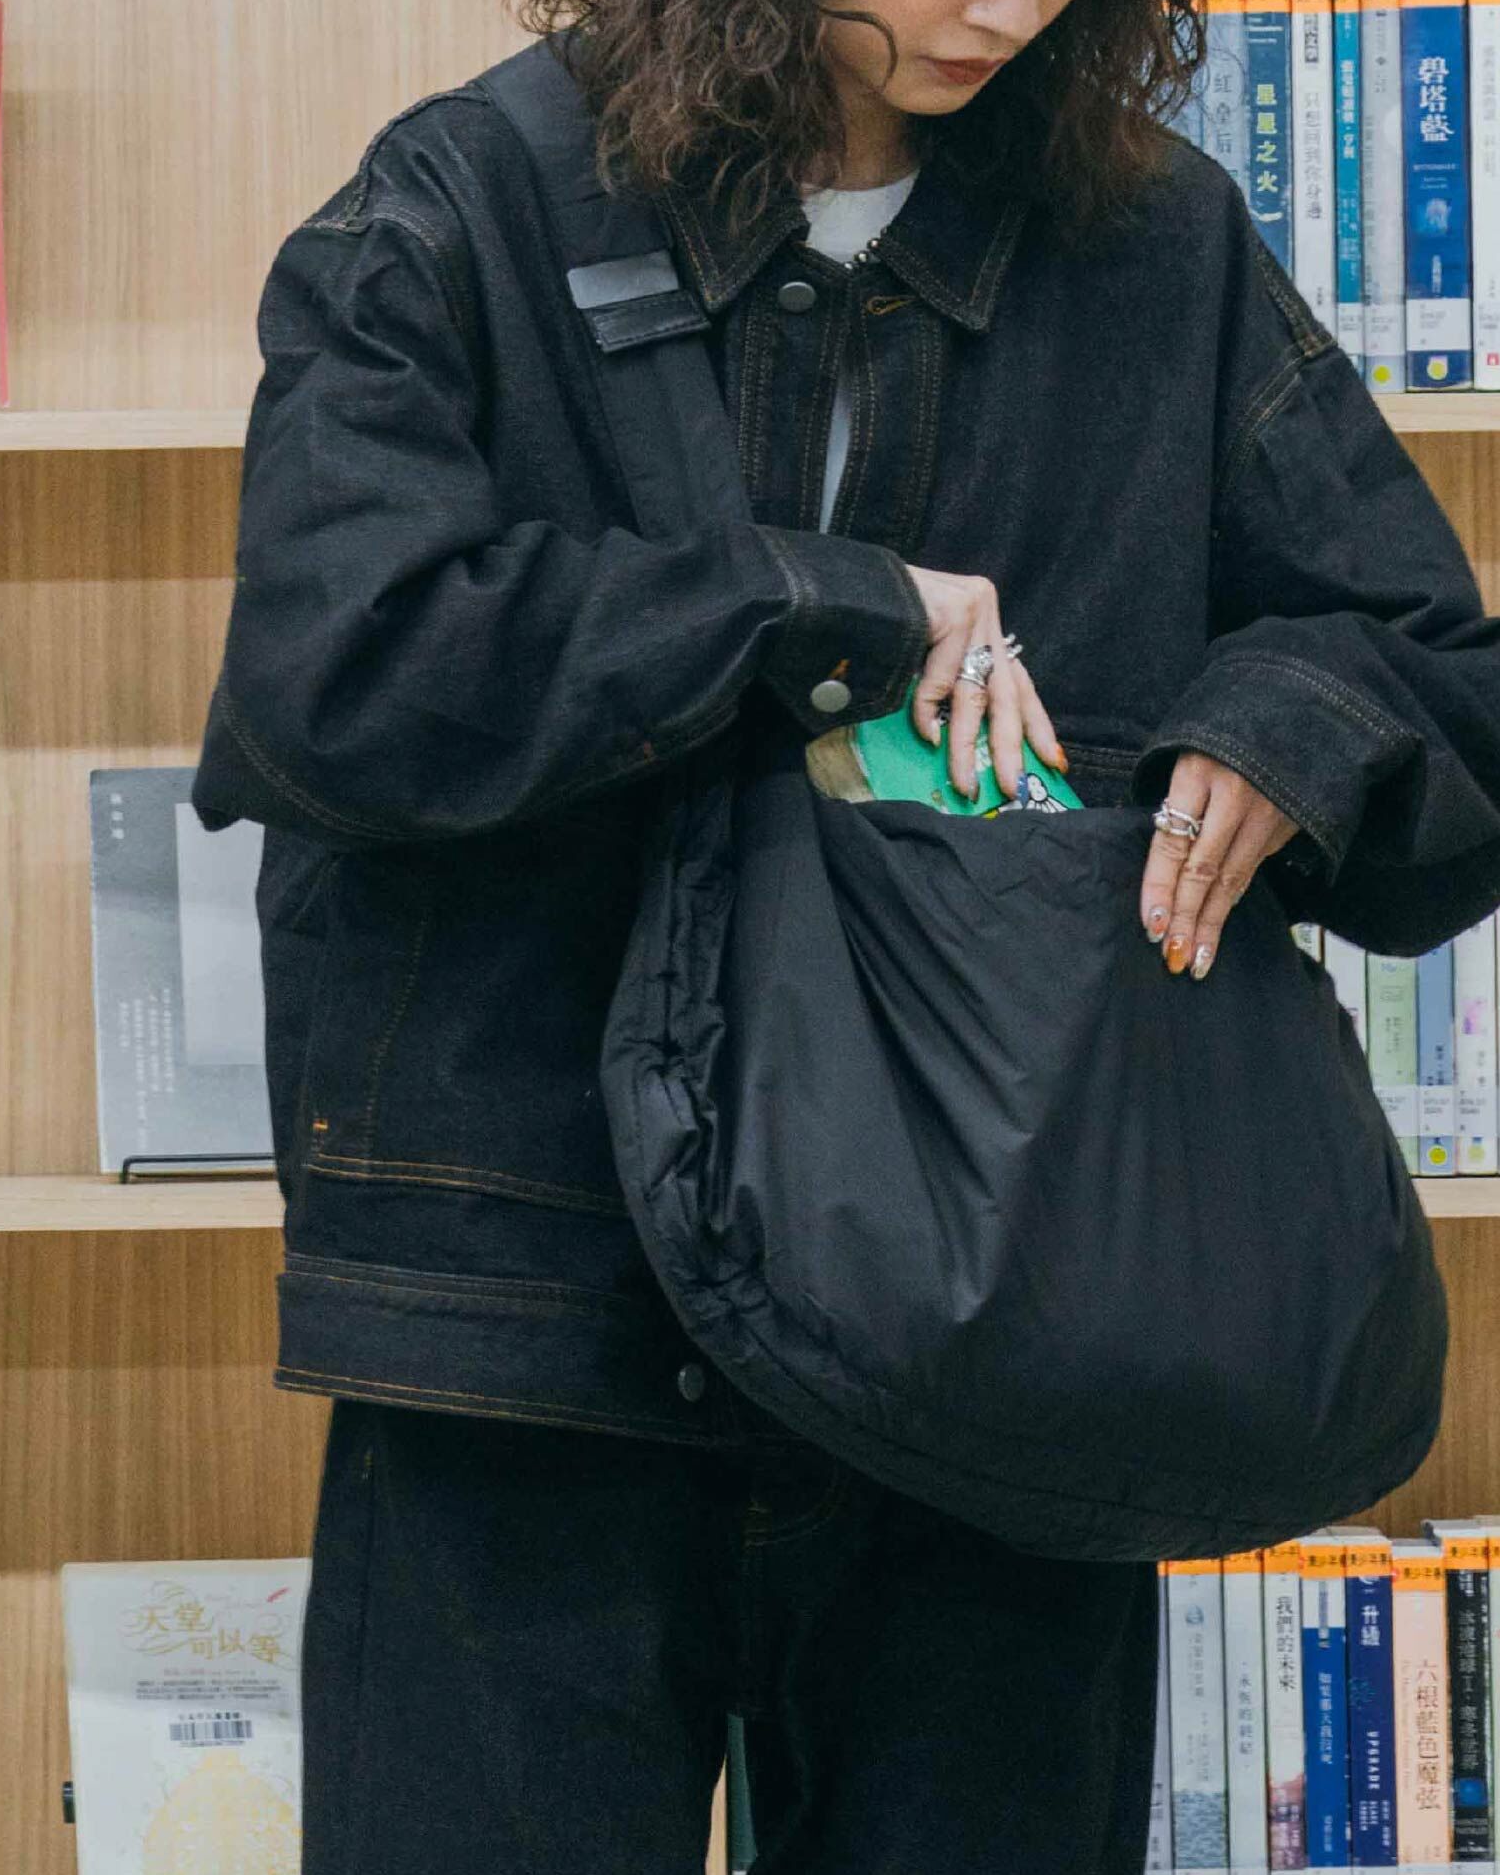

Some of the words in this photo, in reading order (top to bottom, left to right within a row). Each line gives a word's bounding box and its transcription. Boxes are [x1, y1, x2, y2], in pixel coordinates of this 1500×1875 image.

[137, 1602, 206, 1633] 天堂
[1359, 1603, 1381, 1647] 升級
[191, 1628, 282, 1662] 可以等
[1365, 1730, 1381, 1791] UPGRADE
